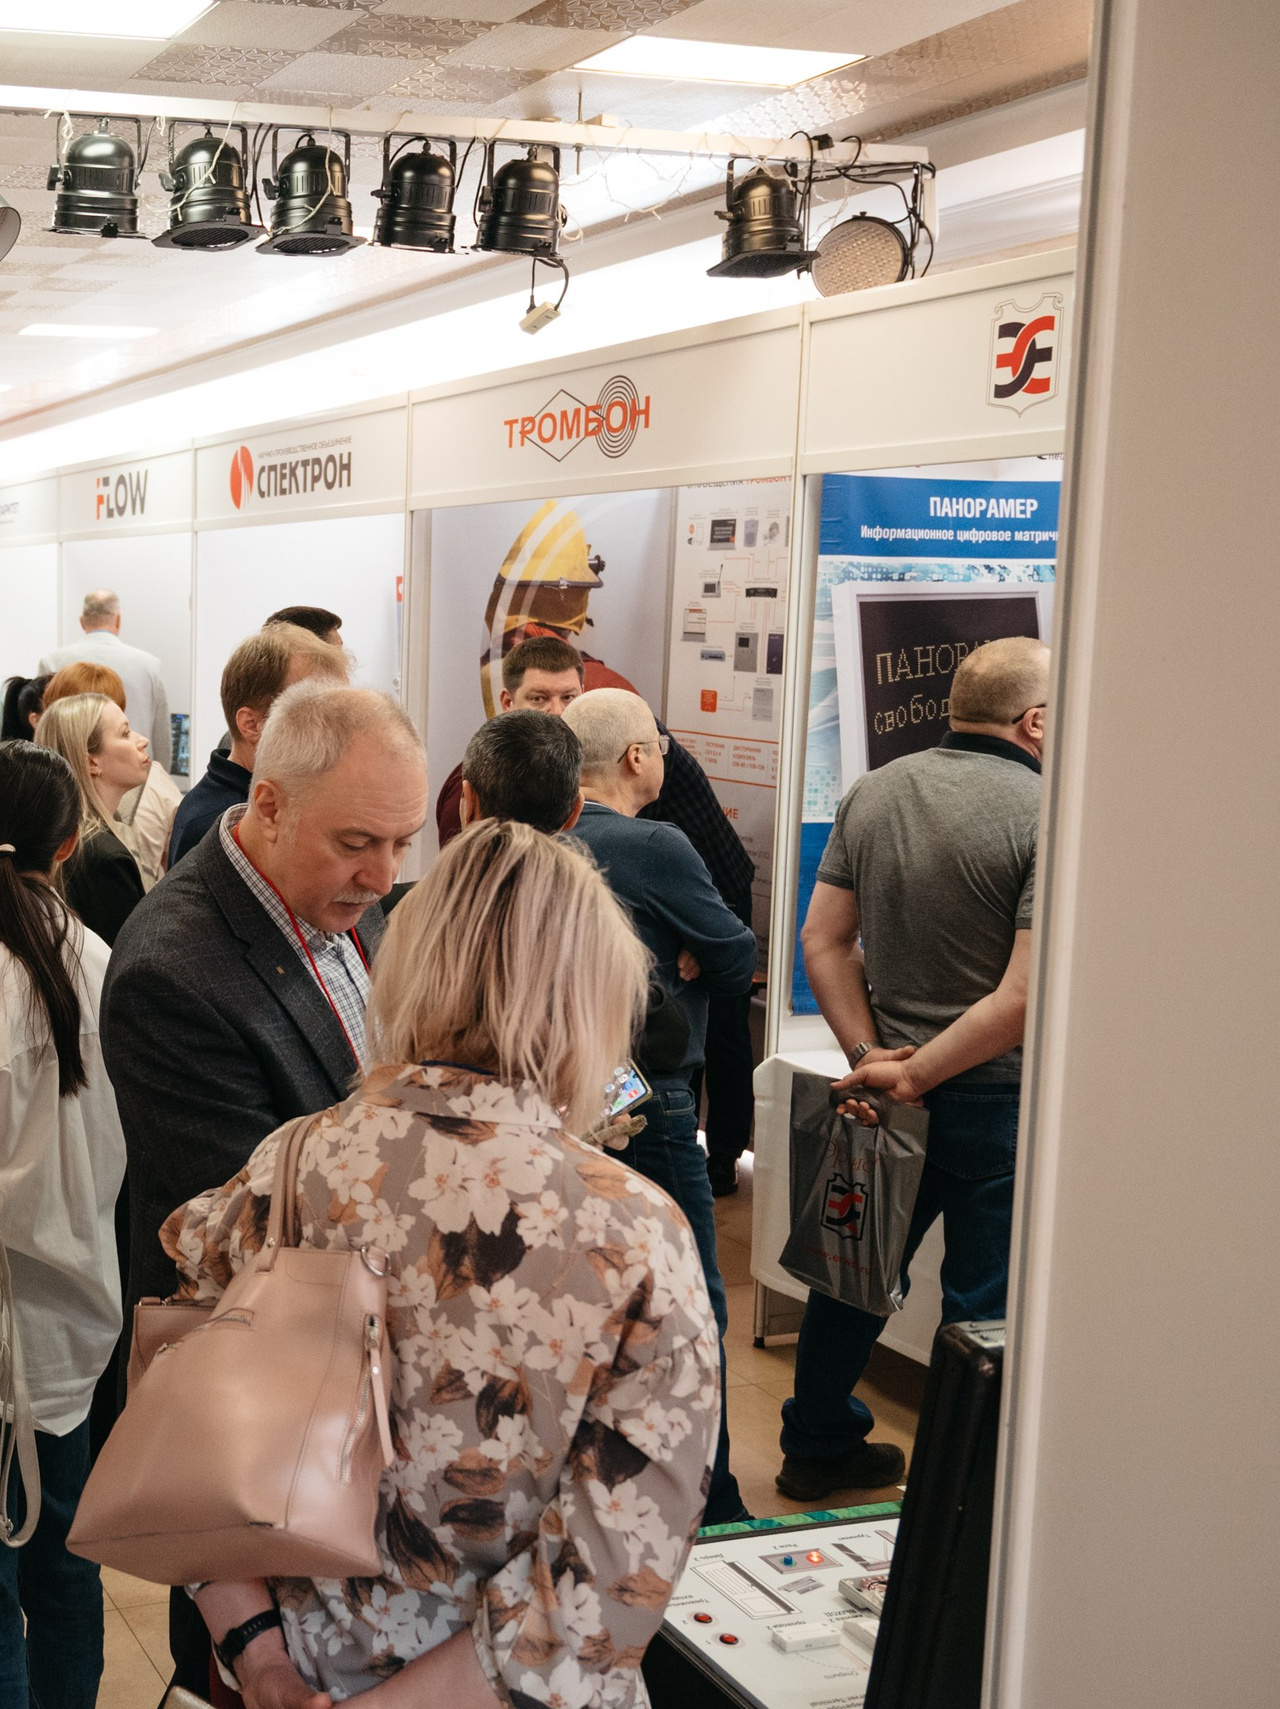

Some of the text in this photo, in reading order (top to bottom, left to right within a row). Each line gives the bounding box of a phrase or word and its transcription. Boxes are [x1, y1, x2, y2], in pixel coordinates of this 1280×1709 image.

[504, 396, 650, 448] ТРОМБОН
[257, 452, 351, 498] СПЕКТРОН
[929, 497, 1038, 518] ПАНОРАМЕР
[860, 525, 954, 541] Информационное
[957, 528, 1011, 541] цифровое
